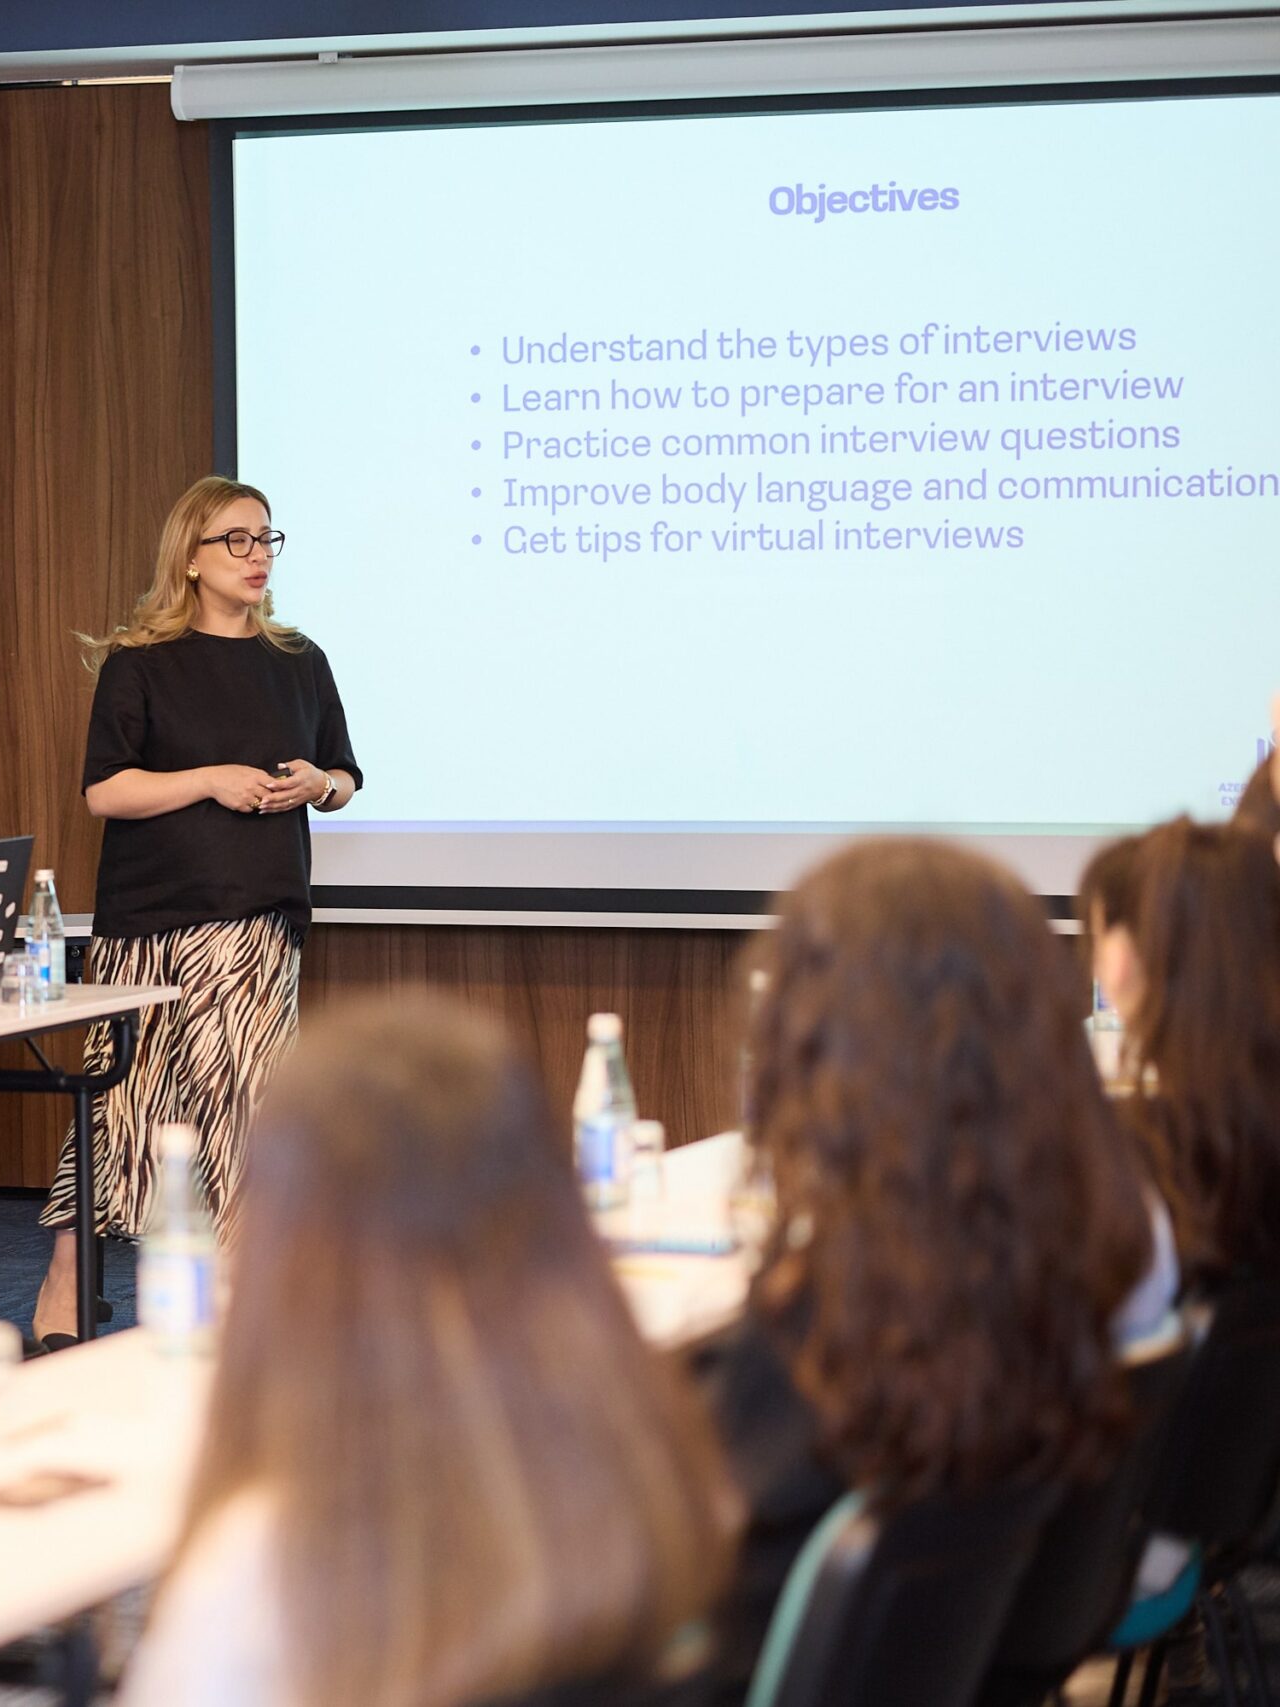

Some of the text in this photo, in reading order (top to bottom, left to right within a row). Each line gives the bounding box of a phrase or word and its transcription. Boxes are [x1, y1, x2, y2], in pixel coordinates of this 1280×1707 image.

[768, 180, 961, 225] Objectives
[502, 320, 1137, 368] Understand the types of interviews
[503, 368, 1185, 418] Learn how to prepare for an interview
[503, 417, 1181, 462] Practice common interview questions
[503, 477, 652, 517] Improve
[661, 471, 748, 514] body
[756, 471, 913, 513] language
[922, 467, 988, 502] and
[503, 518, 1025, 564] Get tips for virtual interviews
